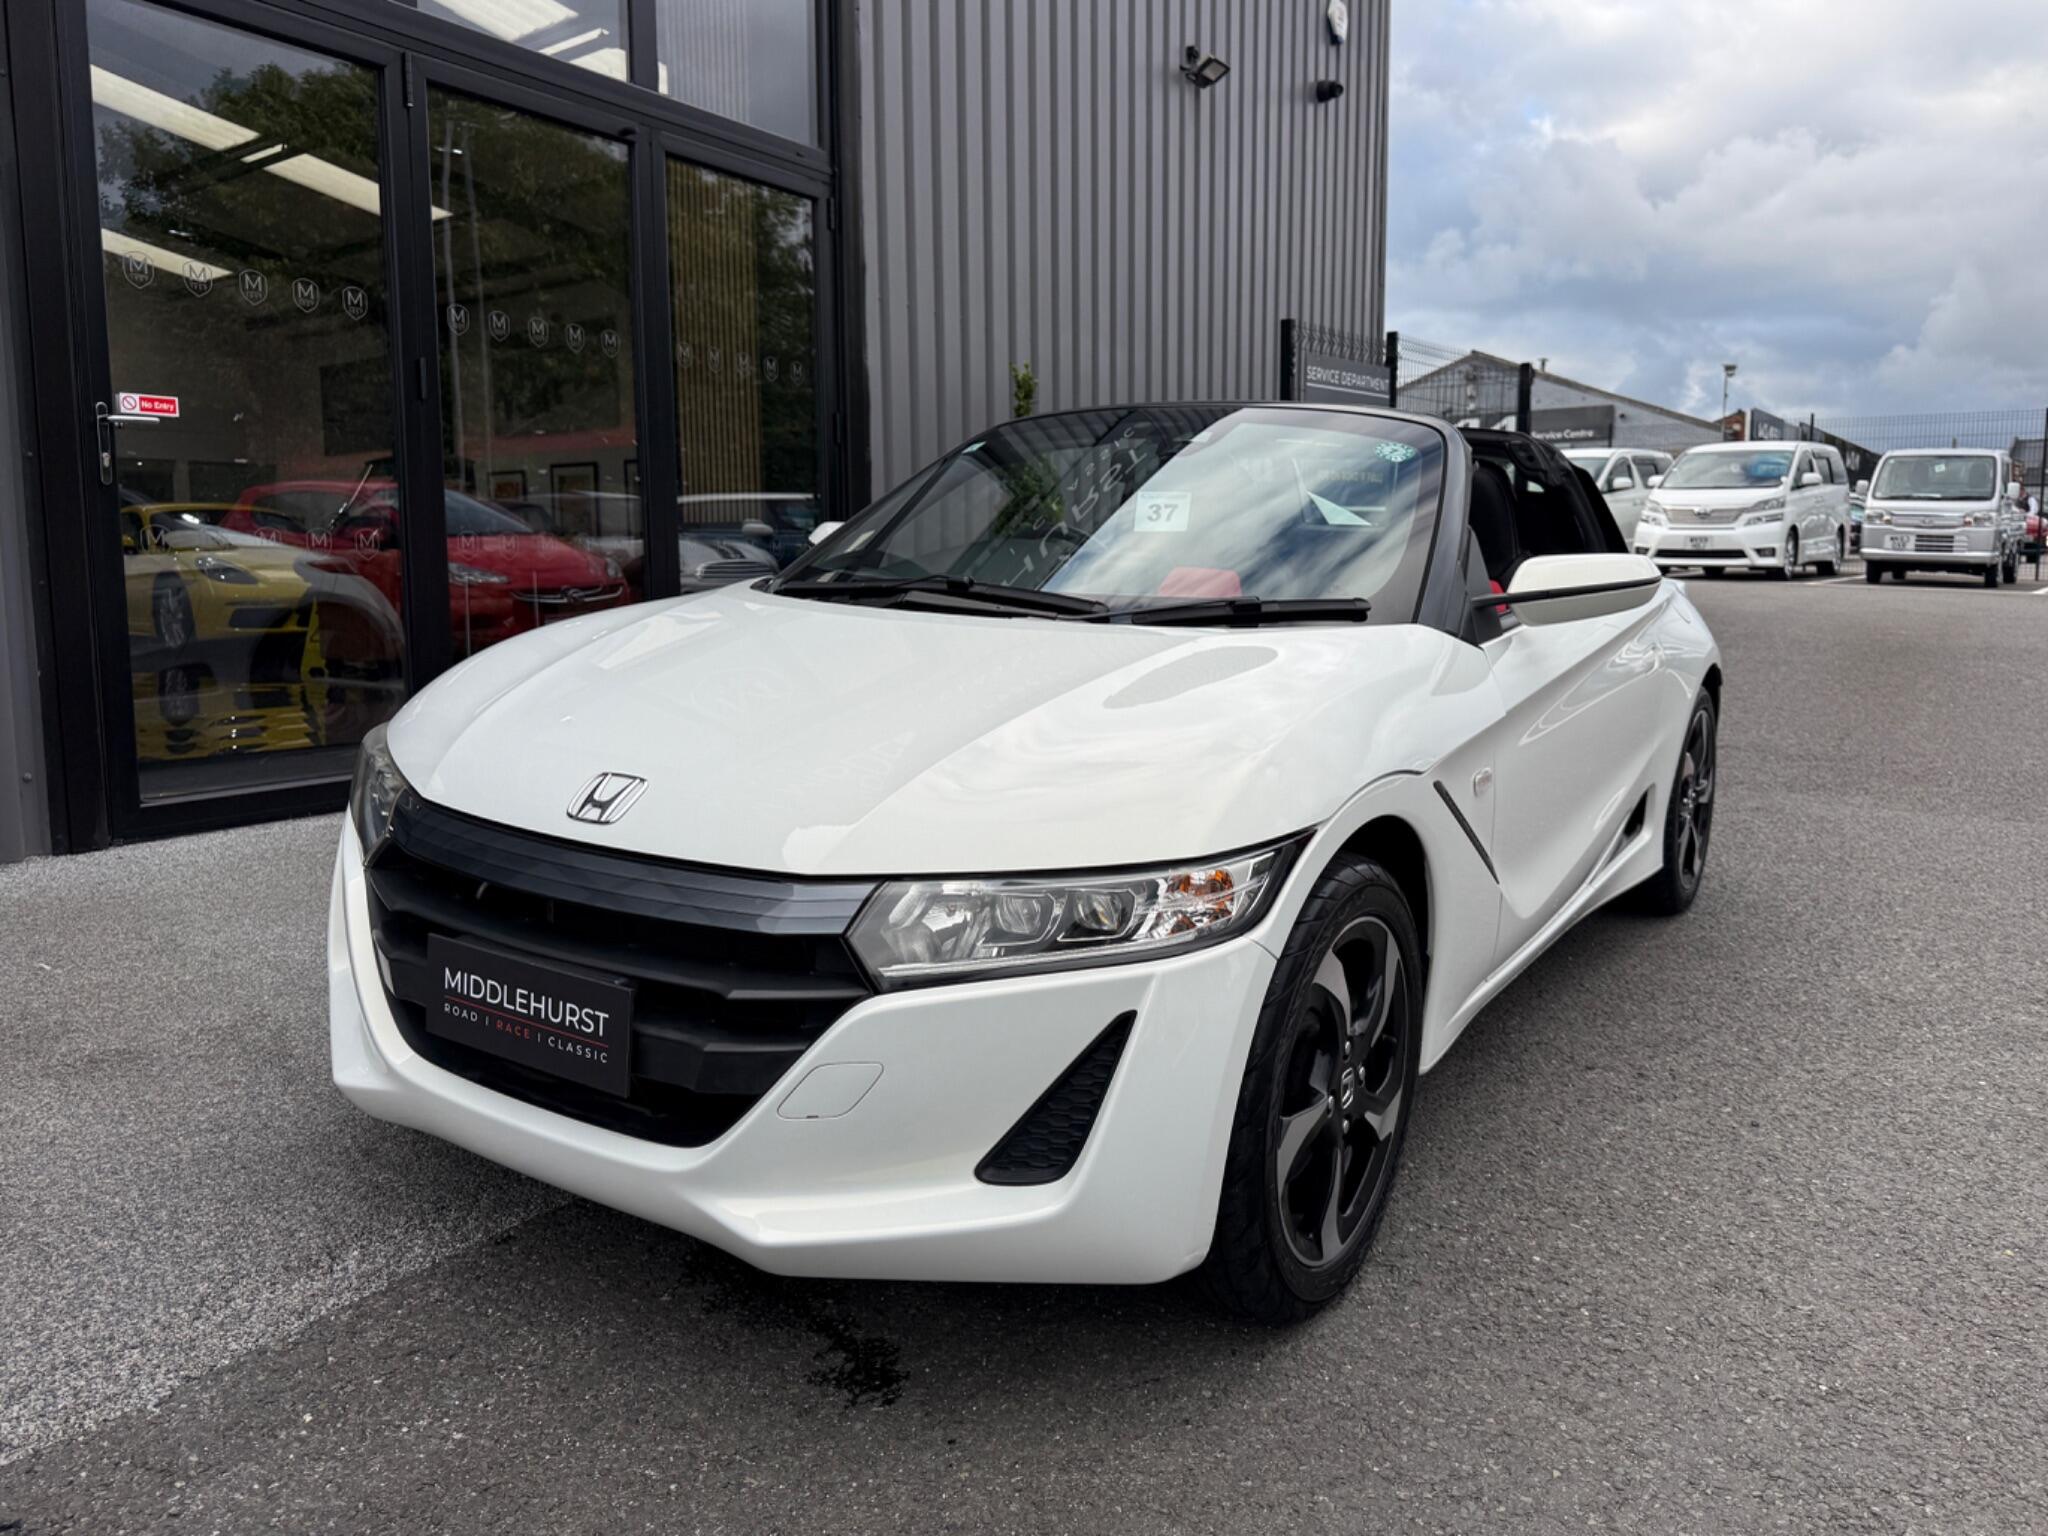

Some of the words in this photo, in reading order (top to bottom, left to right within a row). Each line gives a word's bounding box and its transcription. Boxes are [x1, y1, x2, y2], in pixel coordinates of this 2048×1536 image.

[1306, 365, 1340, 384] SERVICE
[1341, 371, 1390, 392] DEPARTMENT
[141, 400, 153, 409] No
[153, 401, 174, 412] Entry
[1147, 503, 1179, 522] 37
[443, 967, 609, 1037] MIDDLEHURST
[444, 1003, 478, 1023] ROAD
[496, 1021, 530, 1040] RACE
[548, 1036, 608, 1064] CLASSIC
